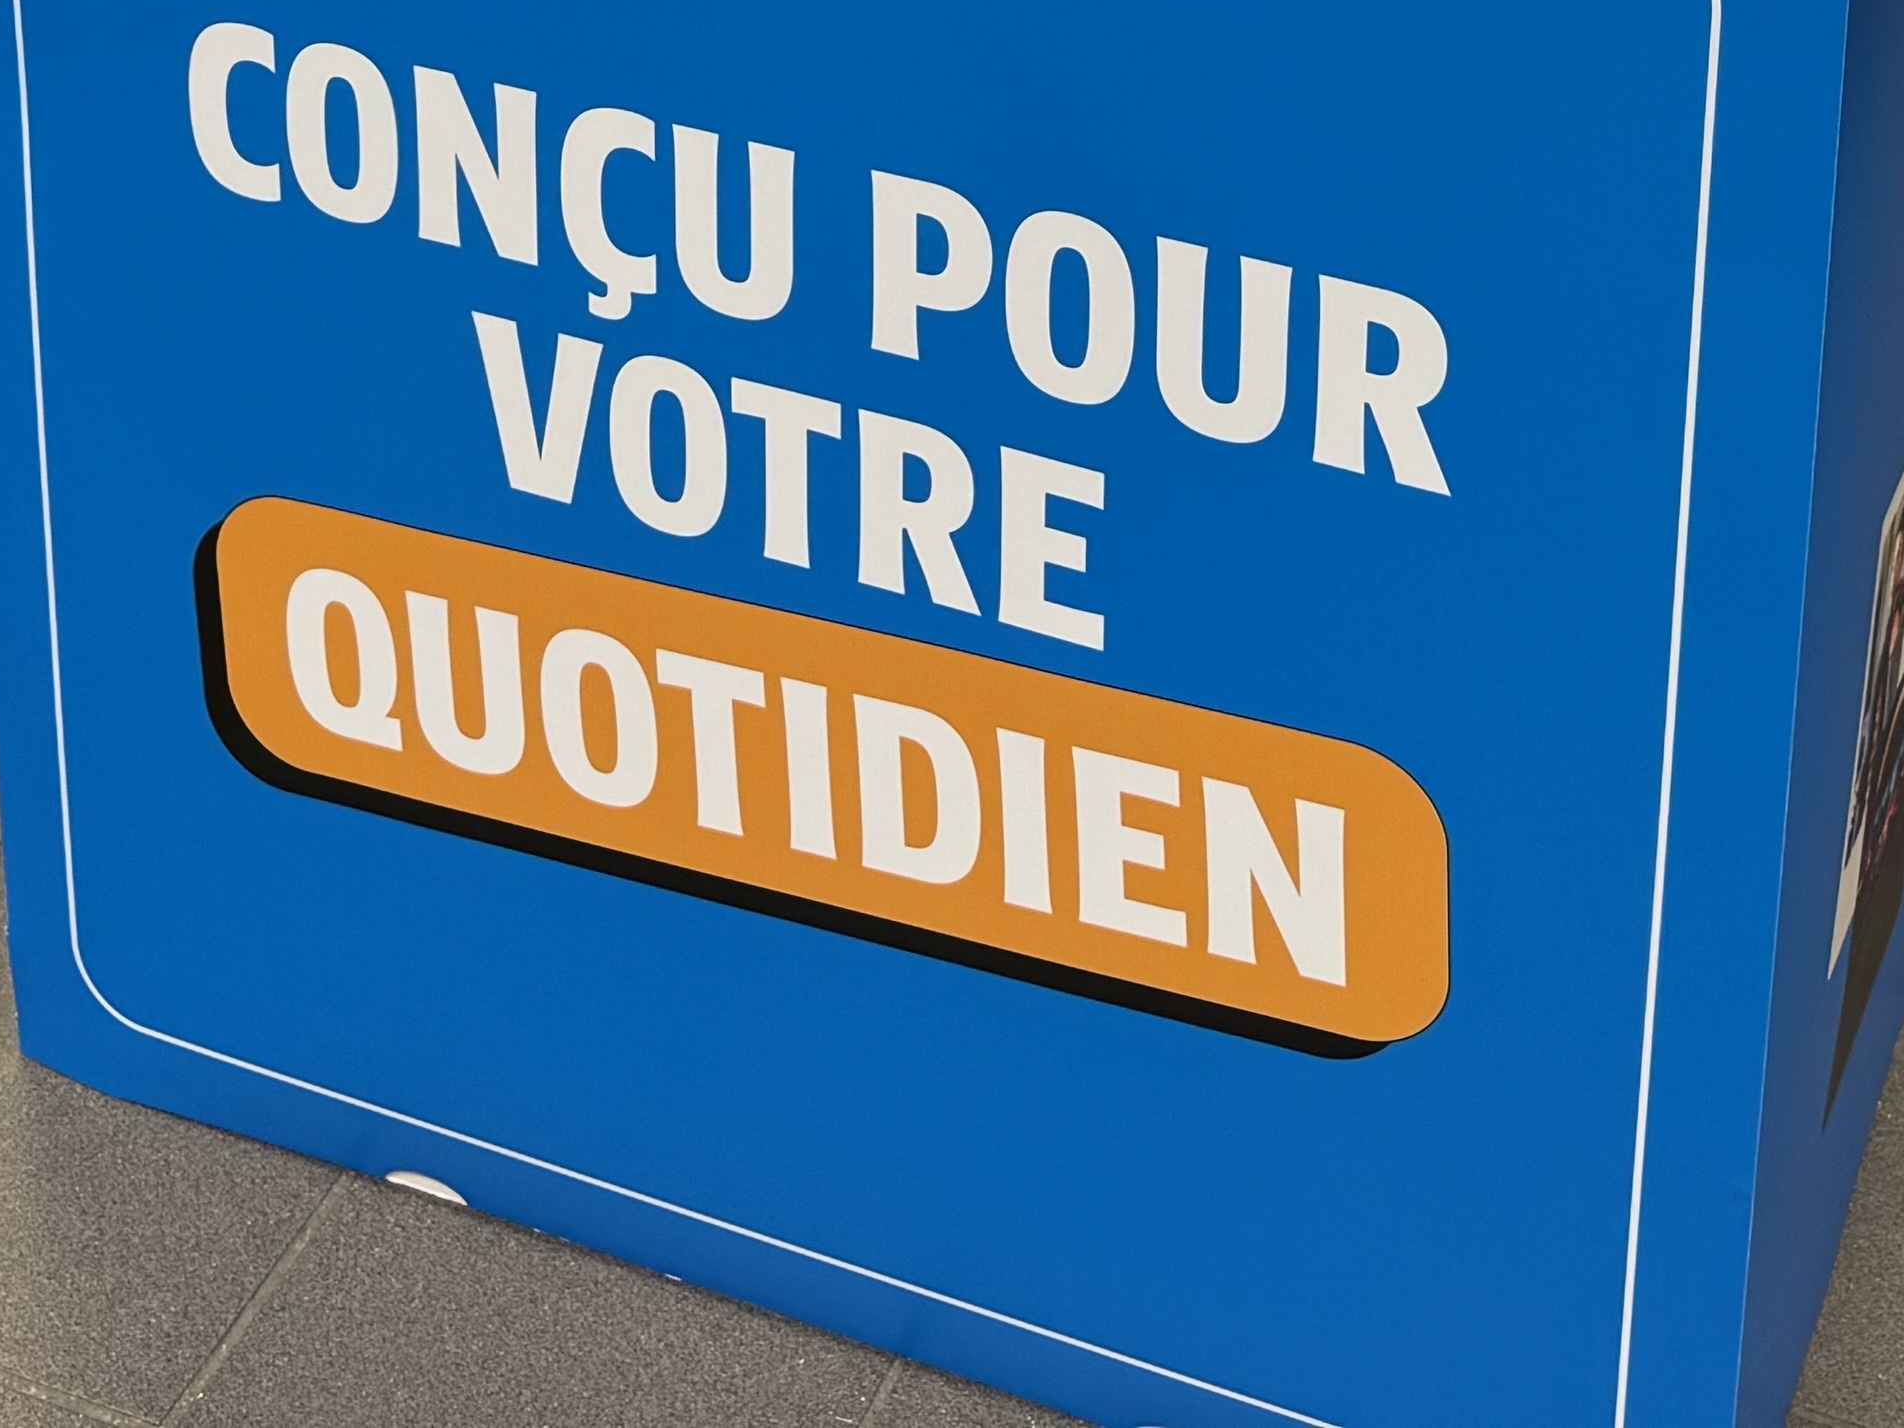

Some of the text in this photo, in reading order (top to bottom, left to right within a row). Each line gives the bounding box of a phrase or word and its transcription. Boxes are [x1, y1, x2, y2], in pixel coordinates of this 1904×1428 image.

[185, 19, 1454, 498] CONÇU POUR
[469, 308, 1108, 654] VOTRE
[284, 565, 1348, 990] QUOTIDIEN
